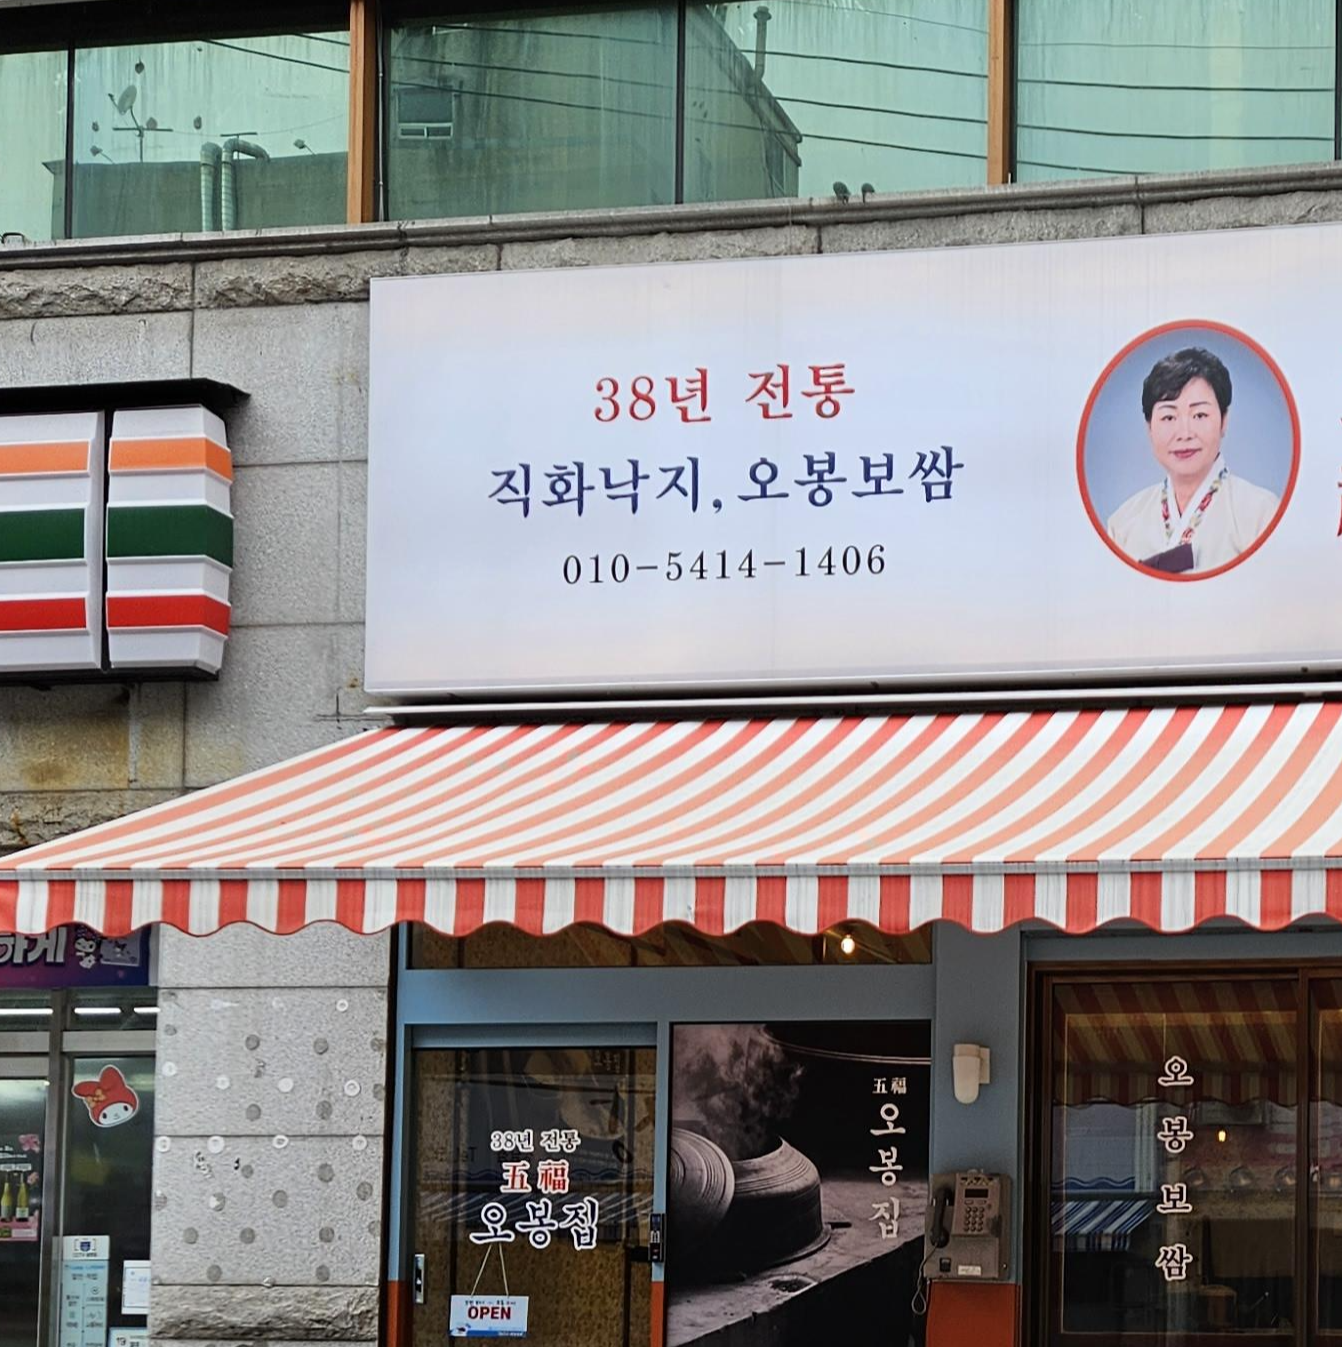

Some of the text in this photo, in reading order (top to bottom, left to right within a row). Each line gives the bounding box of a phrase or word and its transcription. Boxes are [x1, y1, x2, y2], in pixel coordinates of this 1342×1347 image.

[594, 361, 857, 424] 38년 전통
[562, 545, 887, 585] 010-5414-1406
[491, 1128, 581, 1152] 38년 전통
[500, 1159, 570, 1193] 五福
[869, 1102, 906, 1240] 오봉집
[1155, 1054, 1194, 1282] 오봉보쌈
[469, 1196, 600, 1251] 오봉집
[467, 1305, 511, 1320] OPEN
